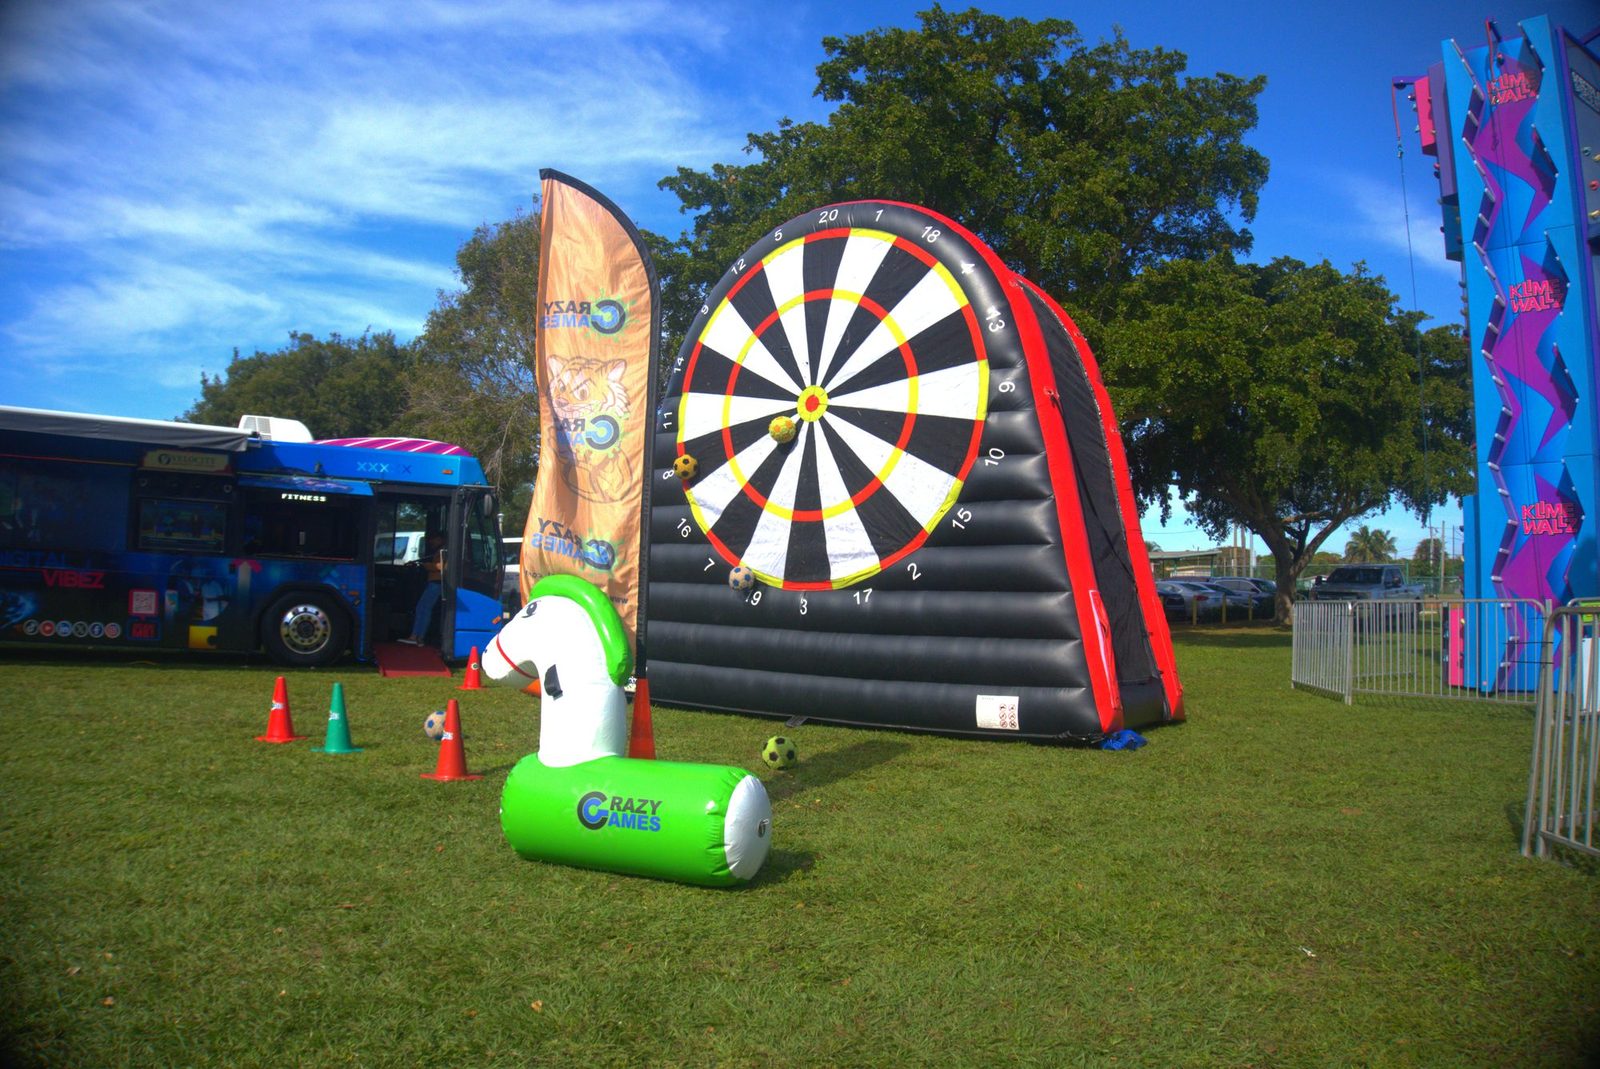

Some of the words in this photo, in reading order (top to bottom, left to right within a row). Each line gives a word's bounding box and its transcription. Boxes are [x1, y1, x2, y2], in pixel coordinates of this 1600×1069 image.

[818, 209, 839, 224] 20
[874, 209, 884, 222] 1
[774, 229, 783, 242] 5
[921, 225, 941, 243] 18
[731, 258, 746, 275] 12
[960, 260, 975, 275] 4
[701, 304, 709, 315] 9
[985, 304, 1005, 332] 13
[673, 356, 685, 373] 14
[663, 411, 673, 429] 11
[984, 447, 1005, 467] 10
[662, 469, 674, 480] 8
[281, 493, 327, 502] FITNESS
[952, 507, 972, 530] 15
[676, 517, 692, 538] 16
[704, 558, 715, 572] 7
[907, 562, 922, 580] 2
[41, 569, 105, 588] VIBEZ
[799, 595, 808, 615] 3
[853, 588, 873, 605] 17
[577, 791, 662, 830] CRAZY
